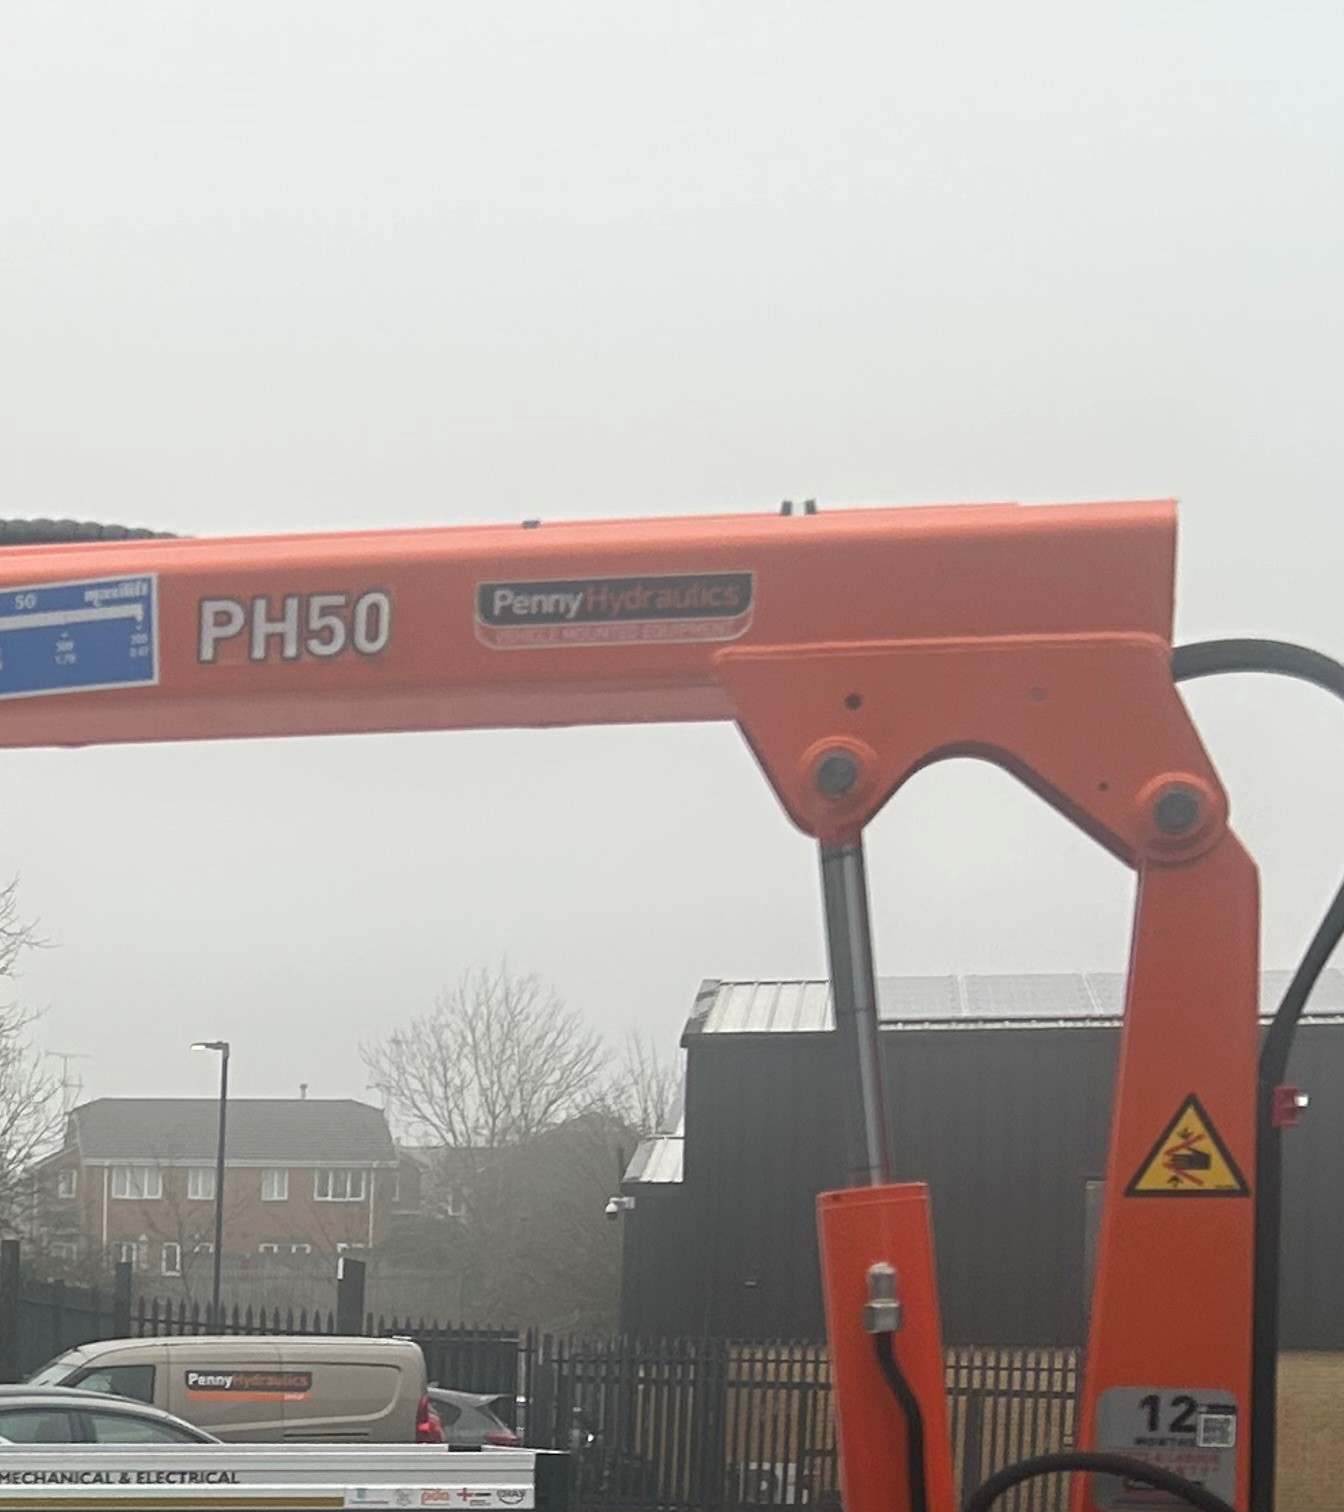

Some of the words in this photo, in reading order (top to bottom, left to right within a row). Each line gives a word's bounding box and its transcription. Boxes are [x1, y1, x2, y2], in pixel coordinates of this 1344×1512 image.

[198, 592, 390, 661] PH50
[1139, 1394, 1198, 1433] 12
[118, 1471, 131, 1485] &
[136, 1470, 241, 1485] ELECTRICAL
